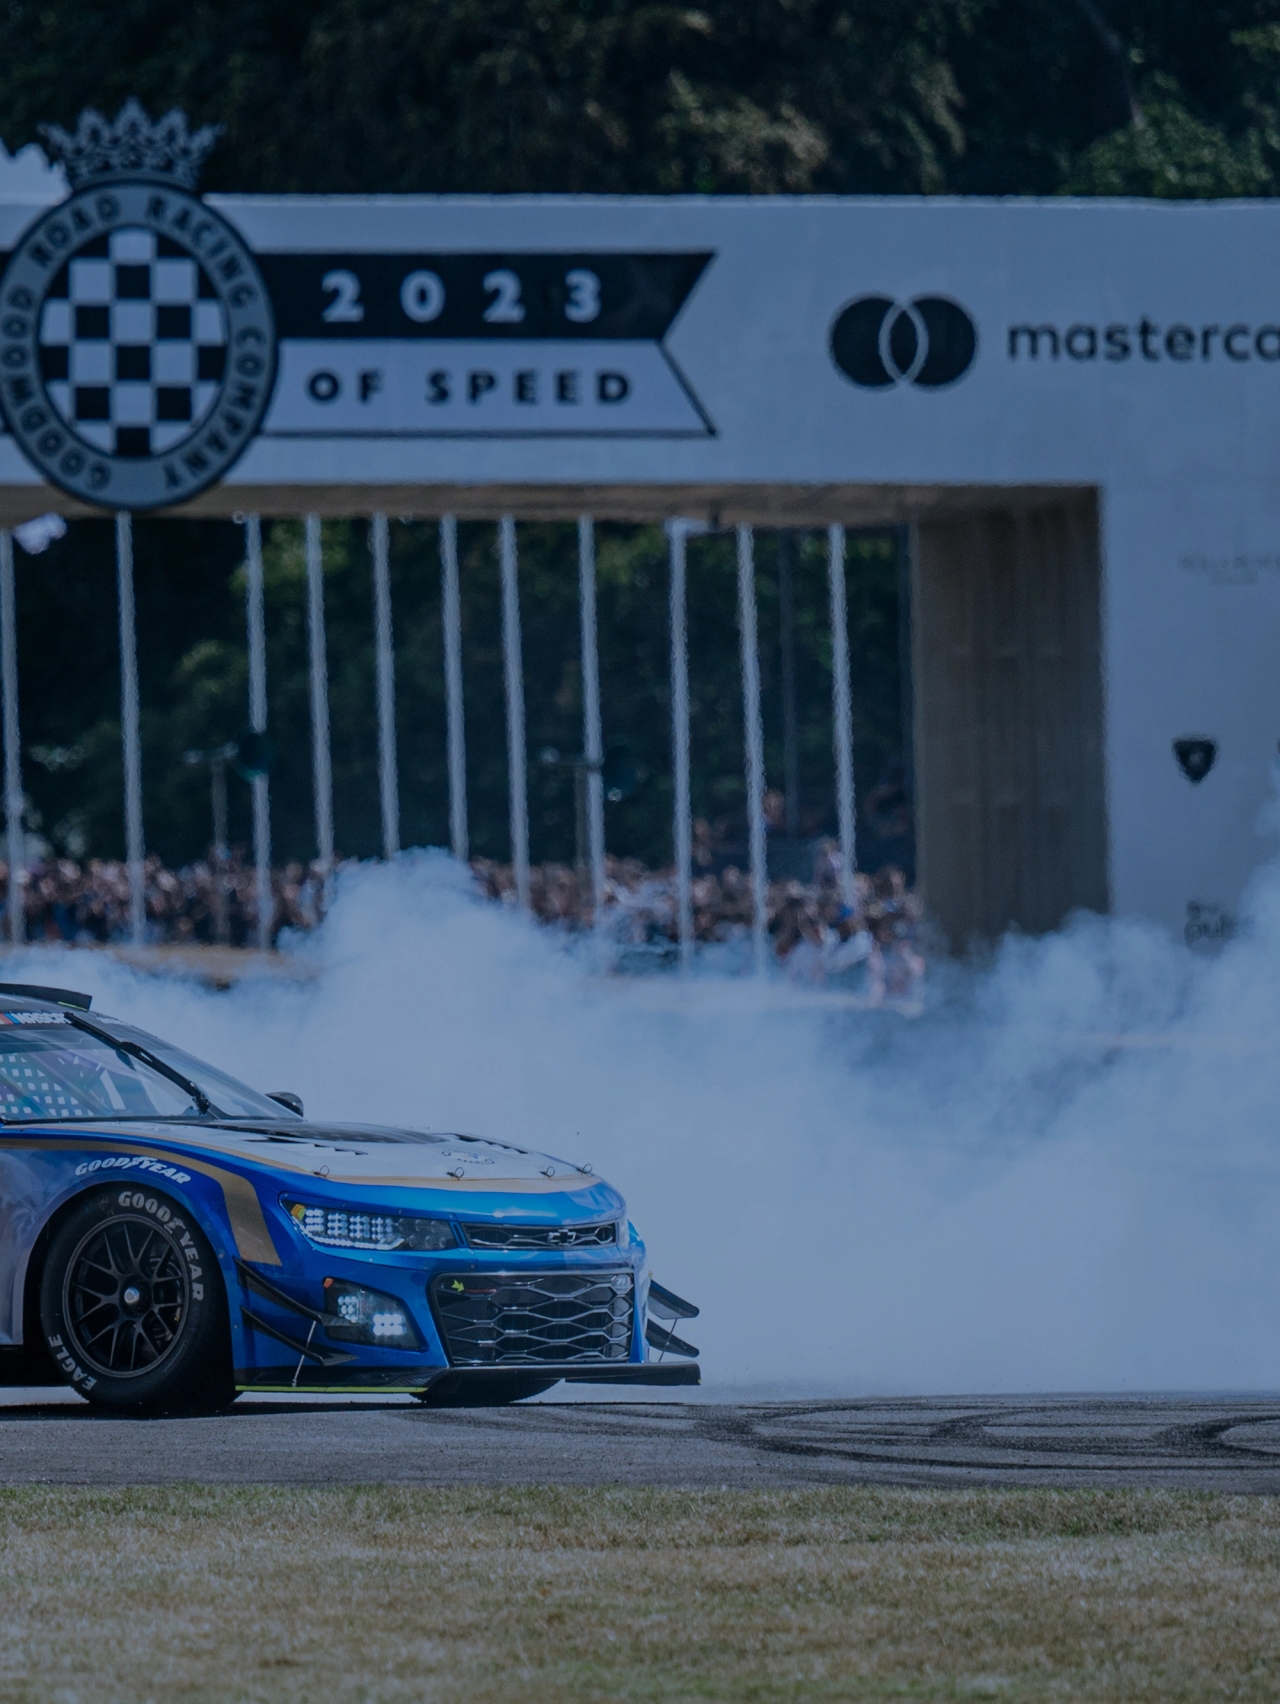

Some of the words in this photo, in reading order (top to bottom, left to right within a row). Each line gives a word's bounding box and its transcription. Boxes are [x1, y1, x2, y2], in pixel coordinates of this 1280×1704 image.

[29, 196, 120, 267] ROAD
[146, 197, 255, 308] RACING
[321, 268, 601, 323] 2023
[1, 286, 111, 490] GOODWOOD
[163, 327, 265, 488] COMPANY
[309, 371, 381, 402] OF
[428, 371, 629, 402] SPEED
[75, 1156, 191, 1184] GOODYEAR
[118, 1191, 204, 1301] GOODYEAR
[48, 1334, 98, 1391] EAGLE
